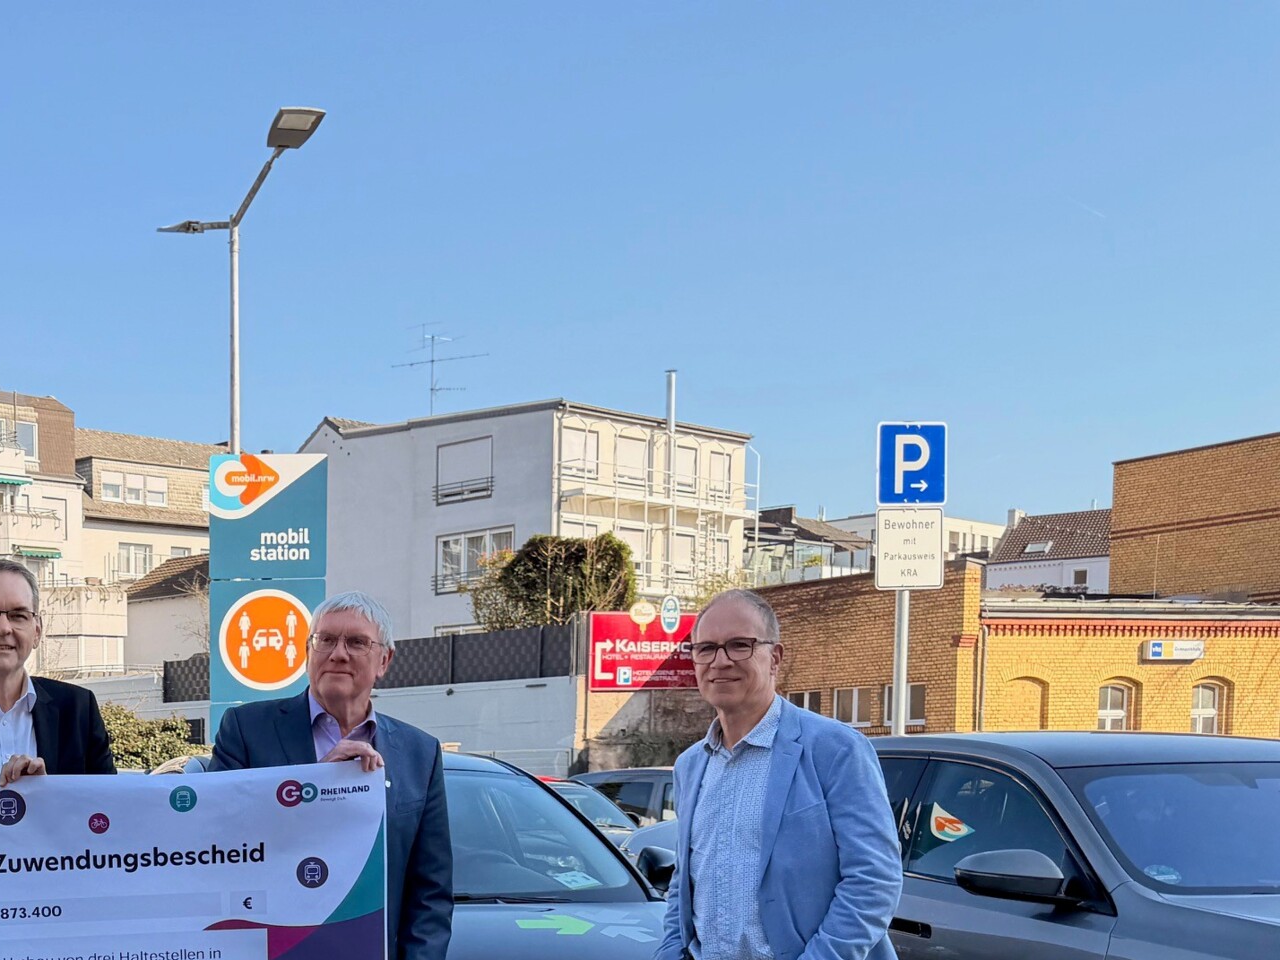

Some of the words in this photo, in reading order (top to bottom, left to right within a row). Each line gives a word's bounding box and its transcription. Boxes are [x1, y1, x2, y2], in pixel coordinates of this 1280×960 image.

[894, 434, 930, 494] P
[231, 474, 275, 483] mobil.nrw
[884, 519, 935, 530] Bewohner
[260, 528, 310, 545] mobil
[903, 537, 916, 545] mit
[250, 545, 310, 561] station
[883, 552, 935, 561] Parkausweis
[900, 569, 918, 577] KRA
[615, 639, 691, 653] KAISERHO
[282, 785, 314, 802] GO
[320, 785, 371, 796] RHEINLAND
[0, 905, 62, 920] 873.400
[242, 897, 253, 910] €
[209, 949, 222, 960] in
